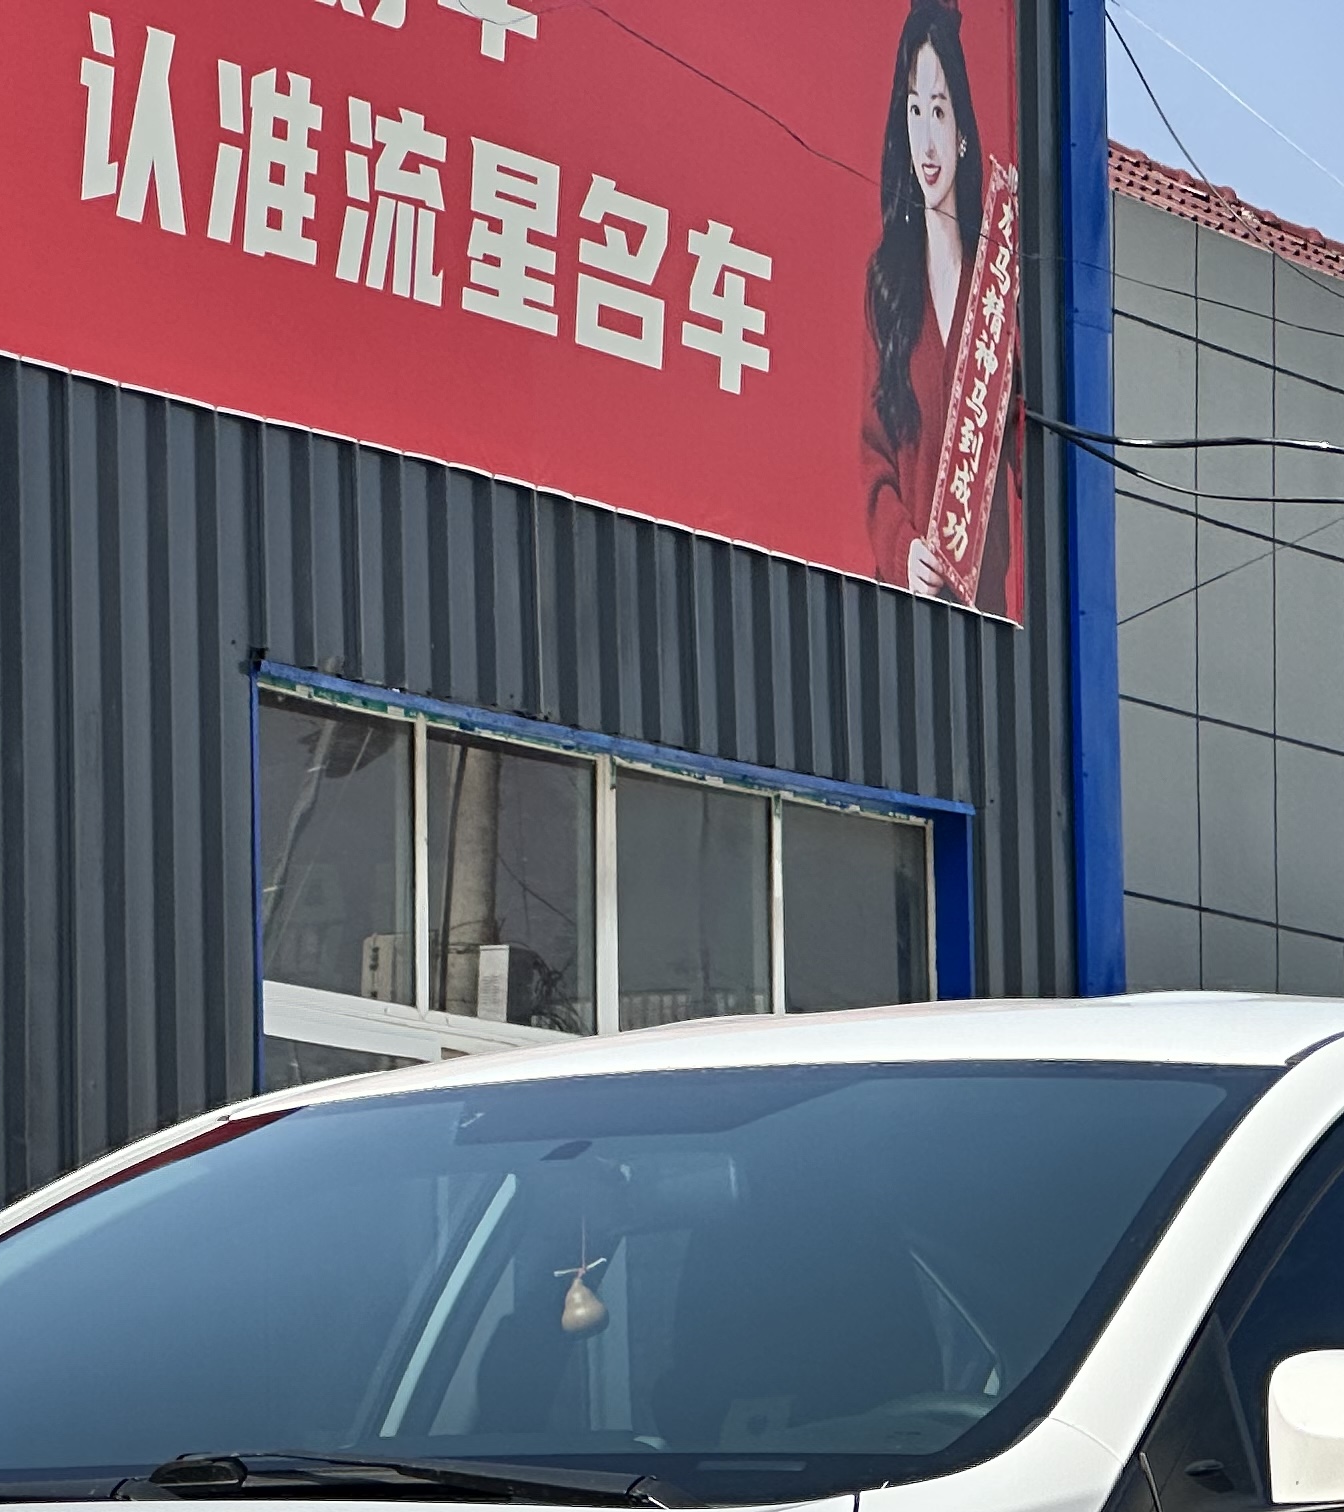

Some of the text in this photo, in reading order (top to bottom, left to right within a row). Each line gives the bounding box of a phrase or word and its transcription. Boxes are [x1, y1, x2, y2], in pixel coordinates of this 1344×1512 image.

[80, 12, 773, 395] 认准流星名车
